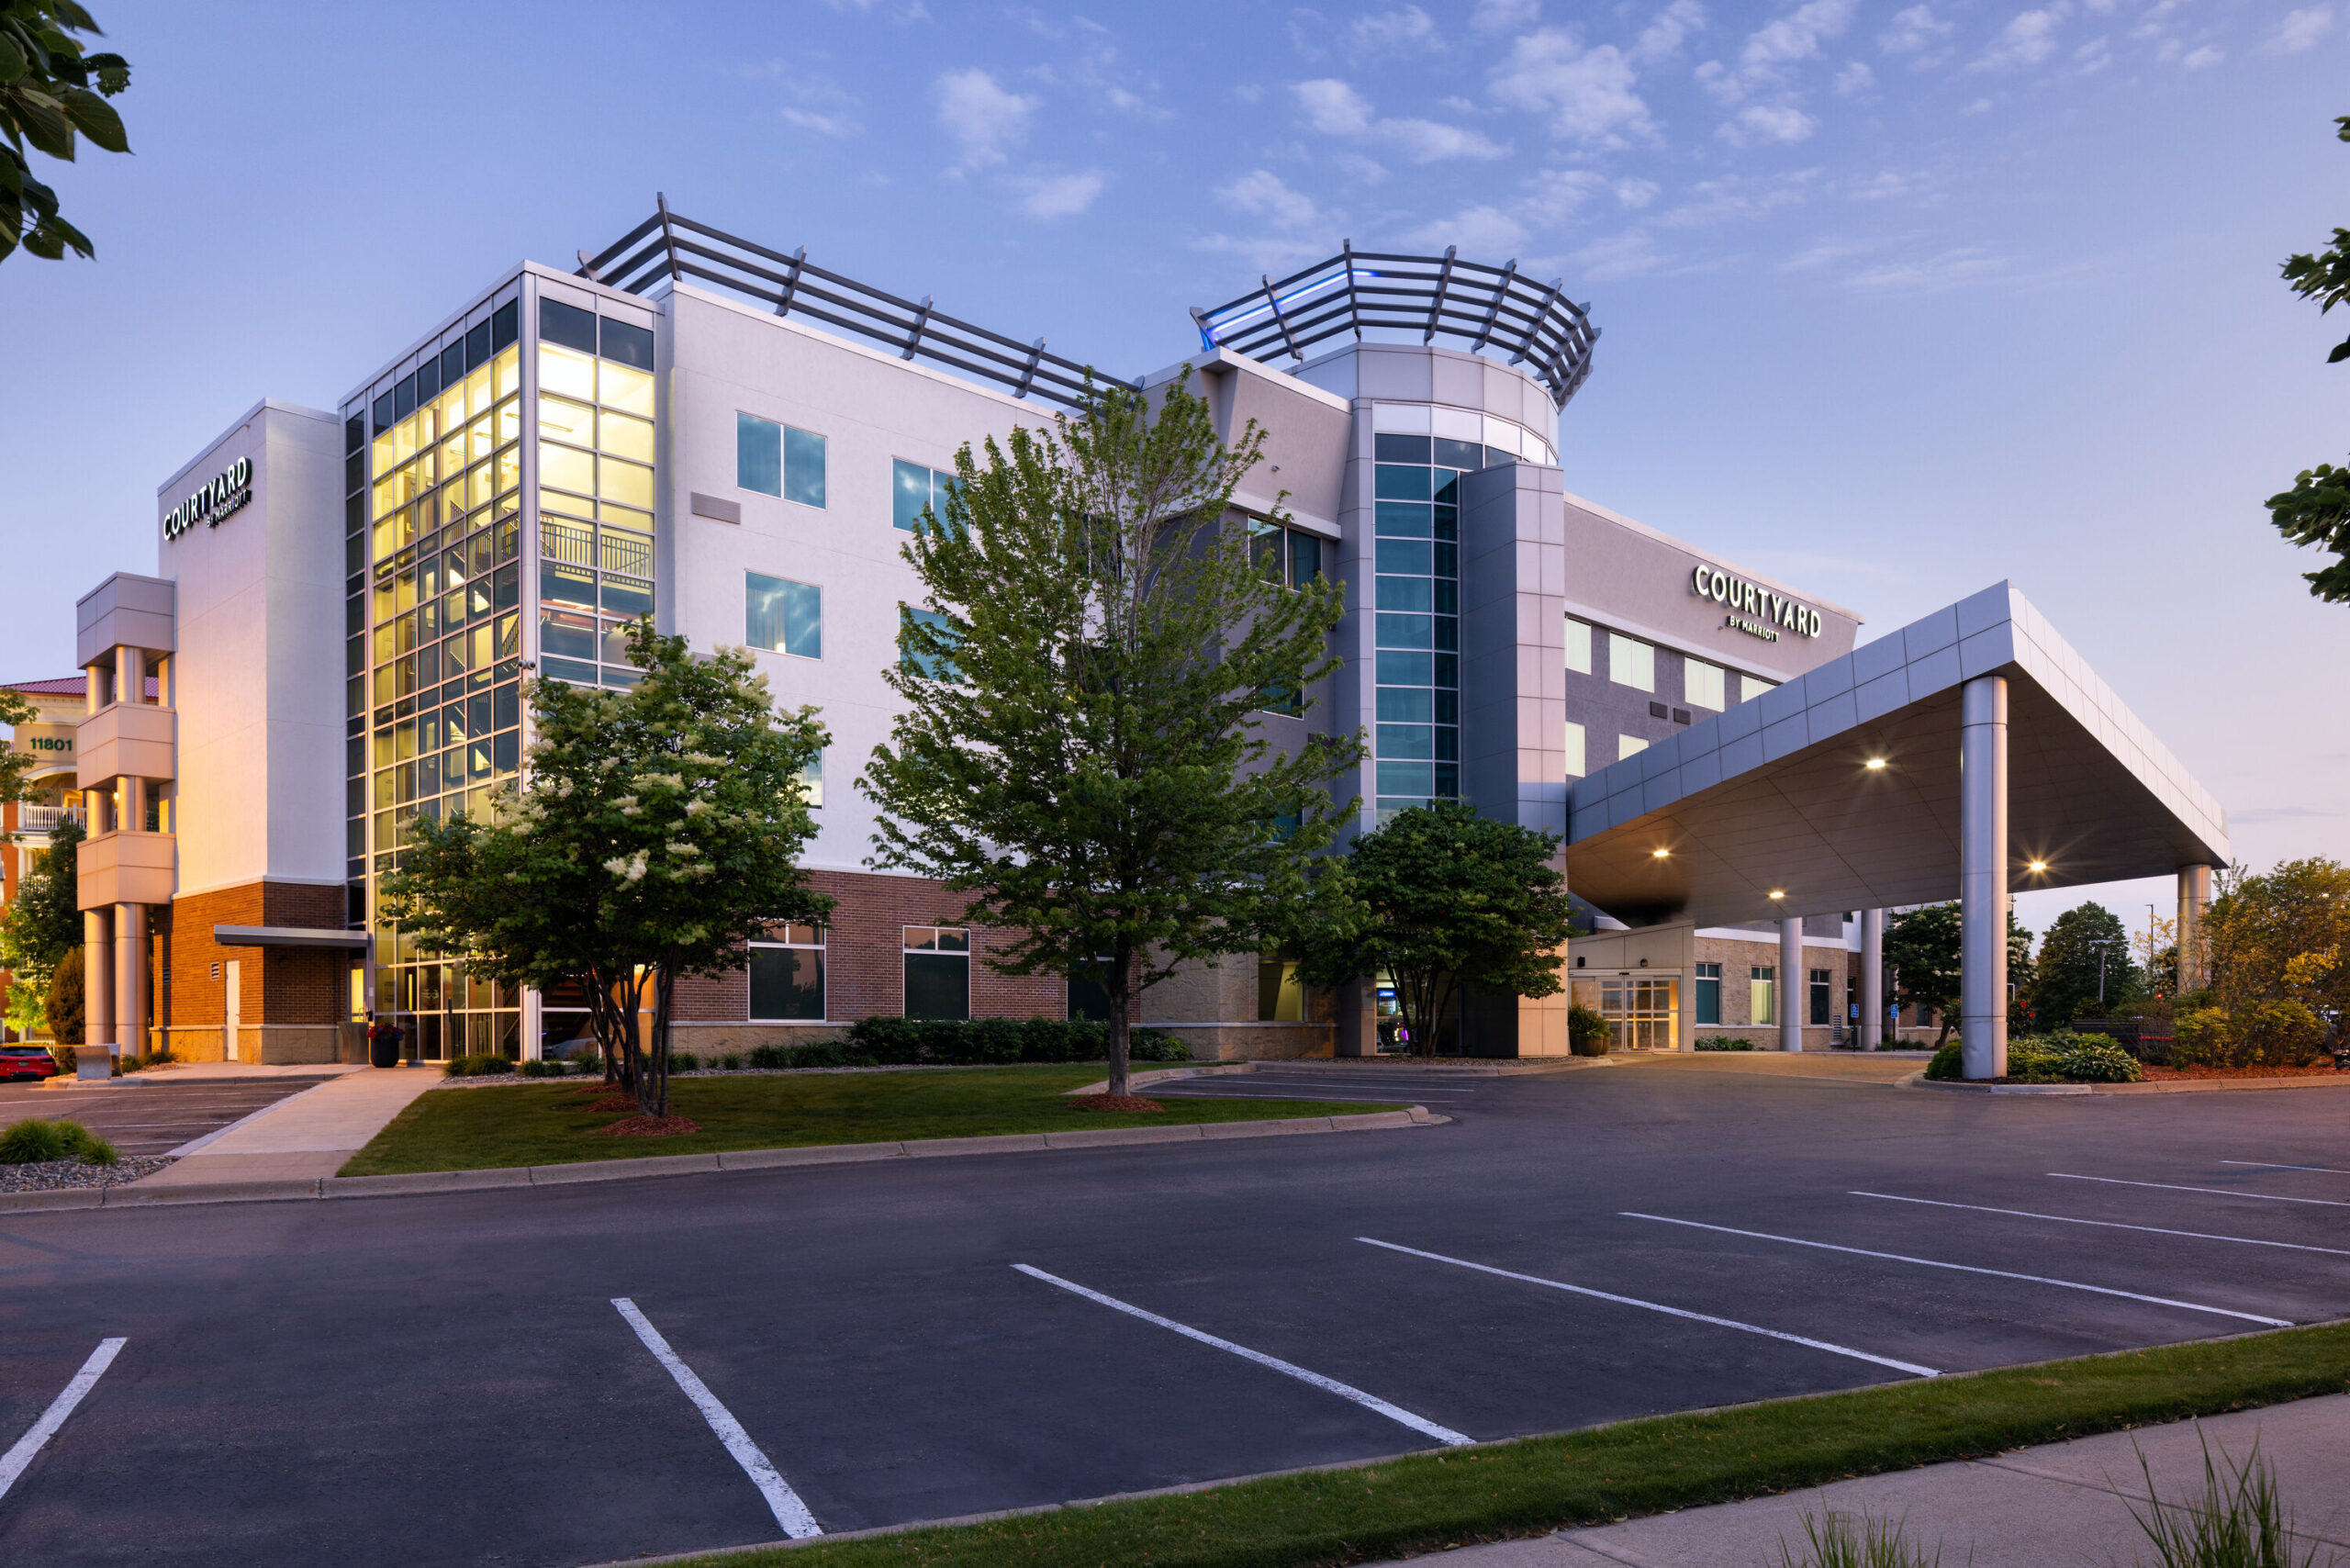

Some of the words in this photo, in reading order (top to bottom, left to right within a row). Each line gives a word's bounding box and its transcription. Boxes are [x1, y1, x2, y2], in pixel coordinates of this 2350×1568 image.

[163, 456, 248, 541] COURTYARD
[1695, 565, 1821, 638] COURTYARD
[1729, 615, 1740, 628] BY
[1742, 620, 1780, 643] MARRIOTT
[30, 737, 73, 752] 11801
